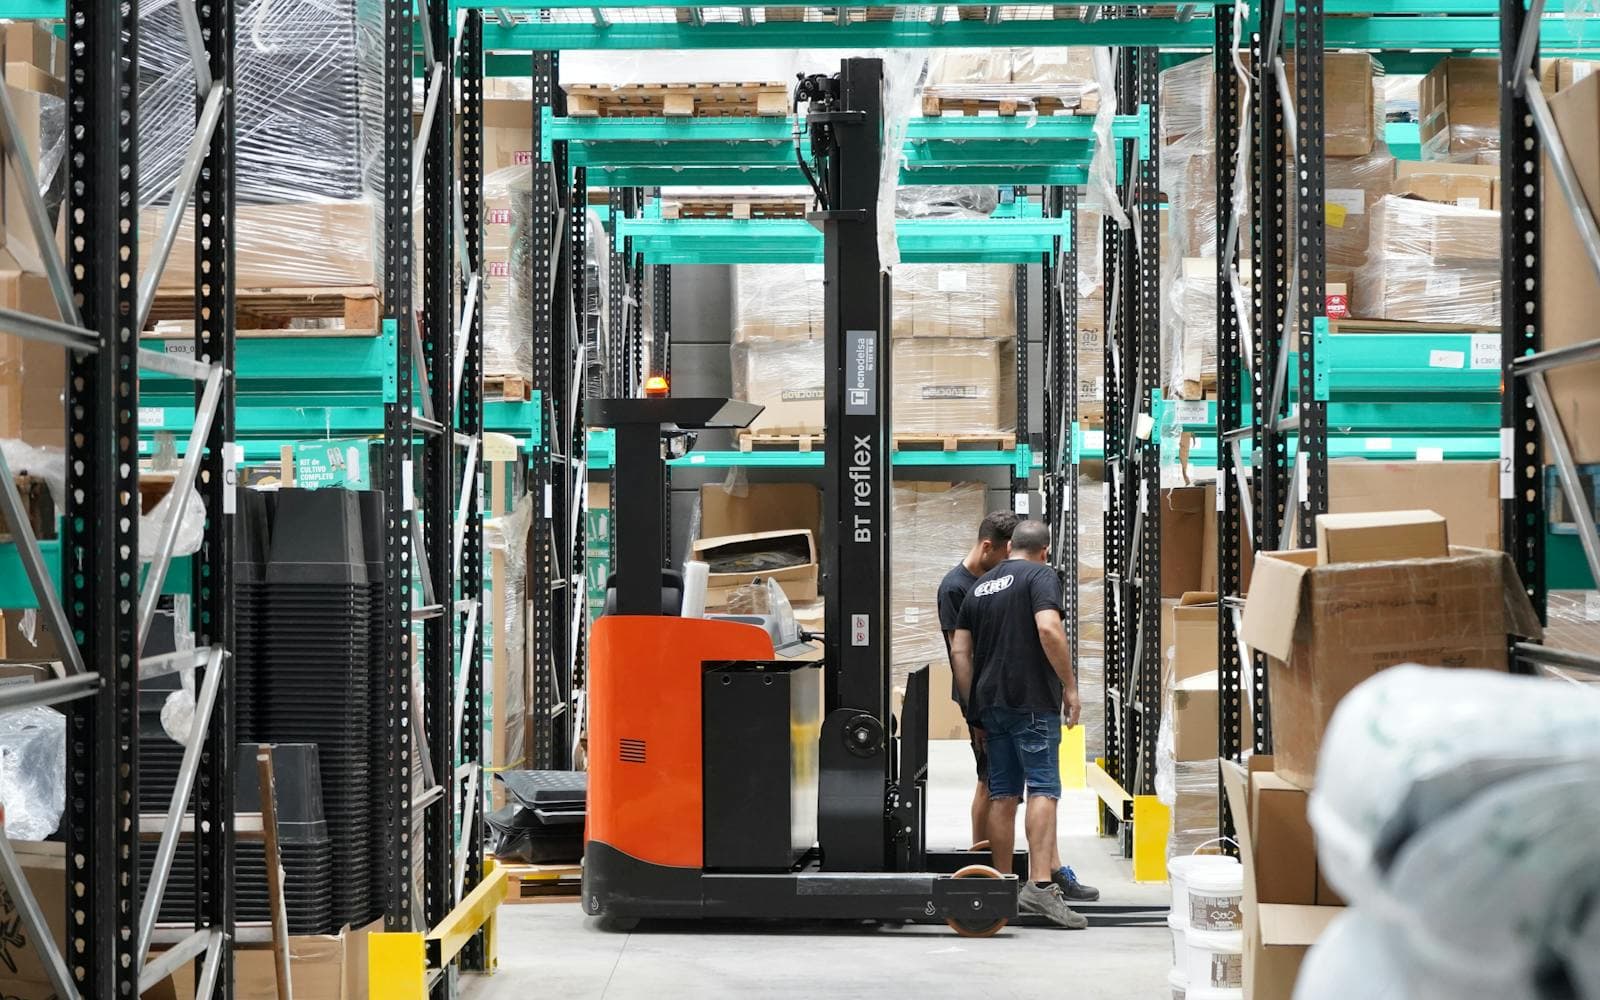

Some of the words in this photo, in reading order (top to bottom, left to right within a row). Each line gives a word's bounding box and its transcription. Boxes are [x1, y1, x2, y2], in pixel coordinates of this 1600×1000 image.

[300, 458, 310, 466] KIT
[311, 458, 320, 466] de
[849, 434, 872, 507] reflex
[300, 473, 334, 481] COMPLETO
[854, 514, 872, 543] BT
